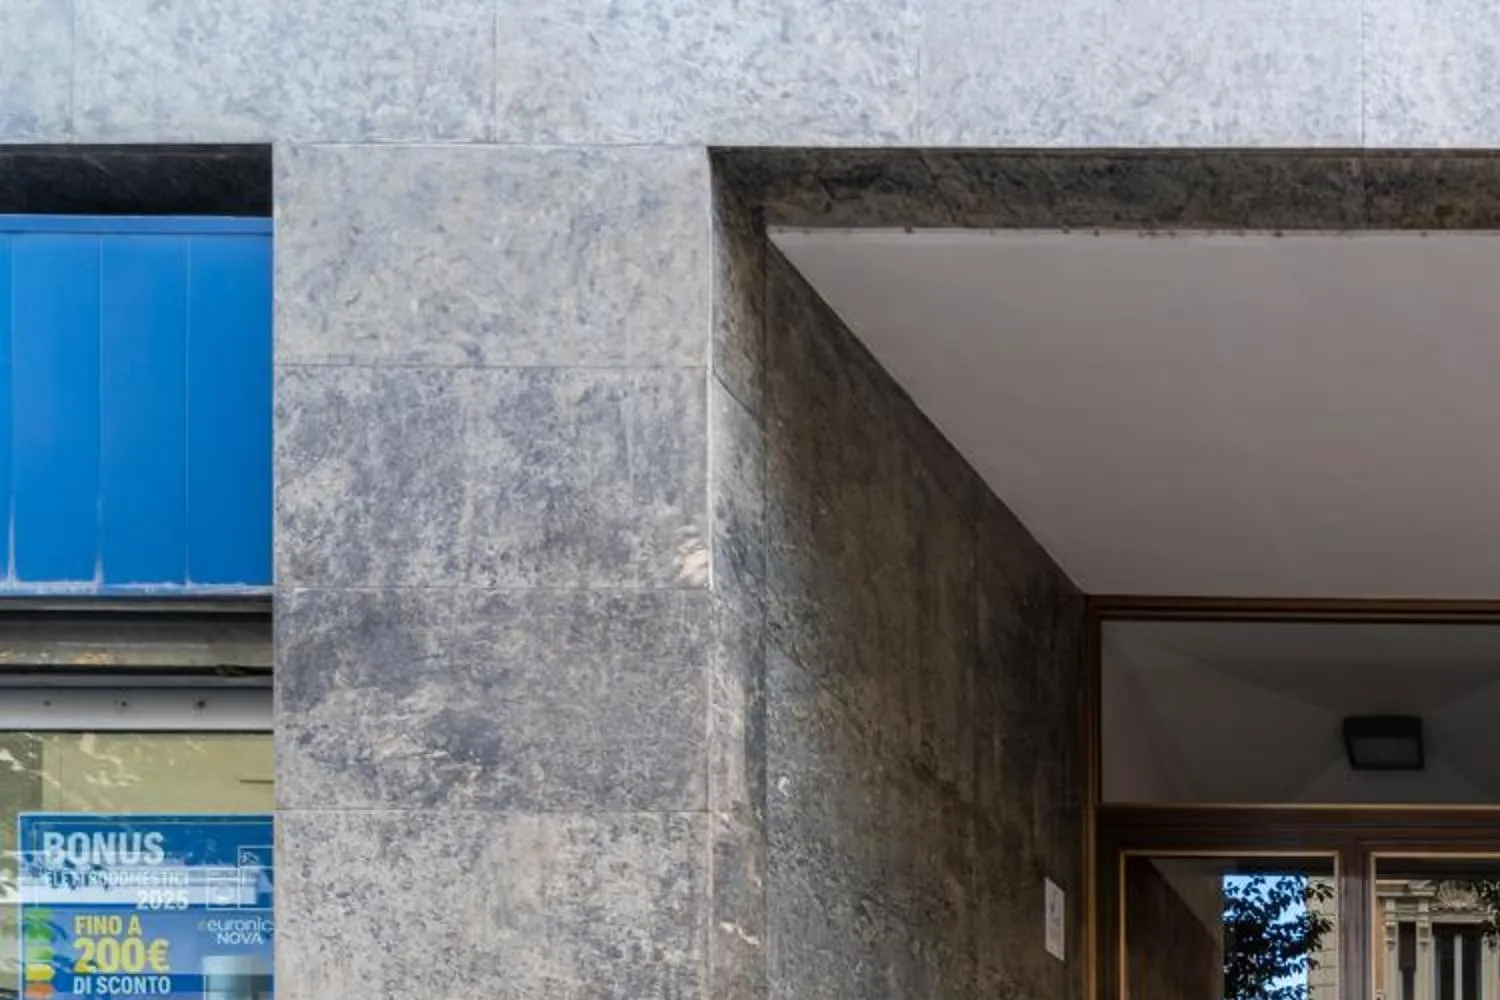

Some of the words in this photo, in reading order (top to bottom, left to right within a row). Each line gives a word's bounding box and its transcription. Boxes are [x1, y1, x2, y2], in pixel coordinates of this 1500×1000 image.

[42, 831, 165, 866] BONUS
[137, 889, 189, 910] 2025
[74, 915, 122, 935] FINO
[127, 915, 142, 935] A
[207, 916, 274, 932] euronic
[217, 931, 264, 945] NOVA
[73, 937, 170, 973] 200€
[73, 976, 93, 994] DI
[97, 976, 171, 994] SCONTO
